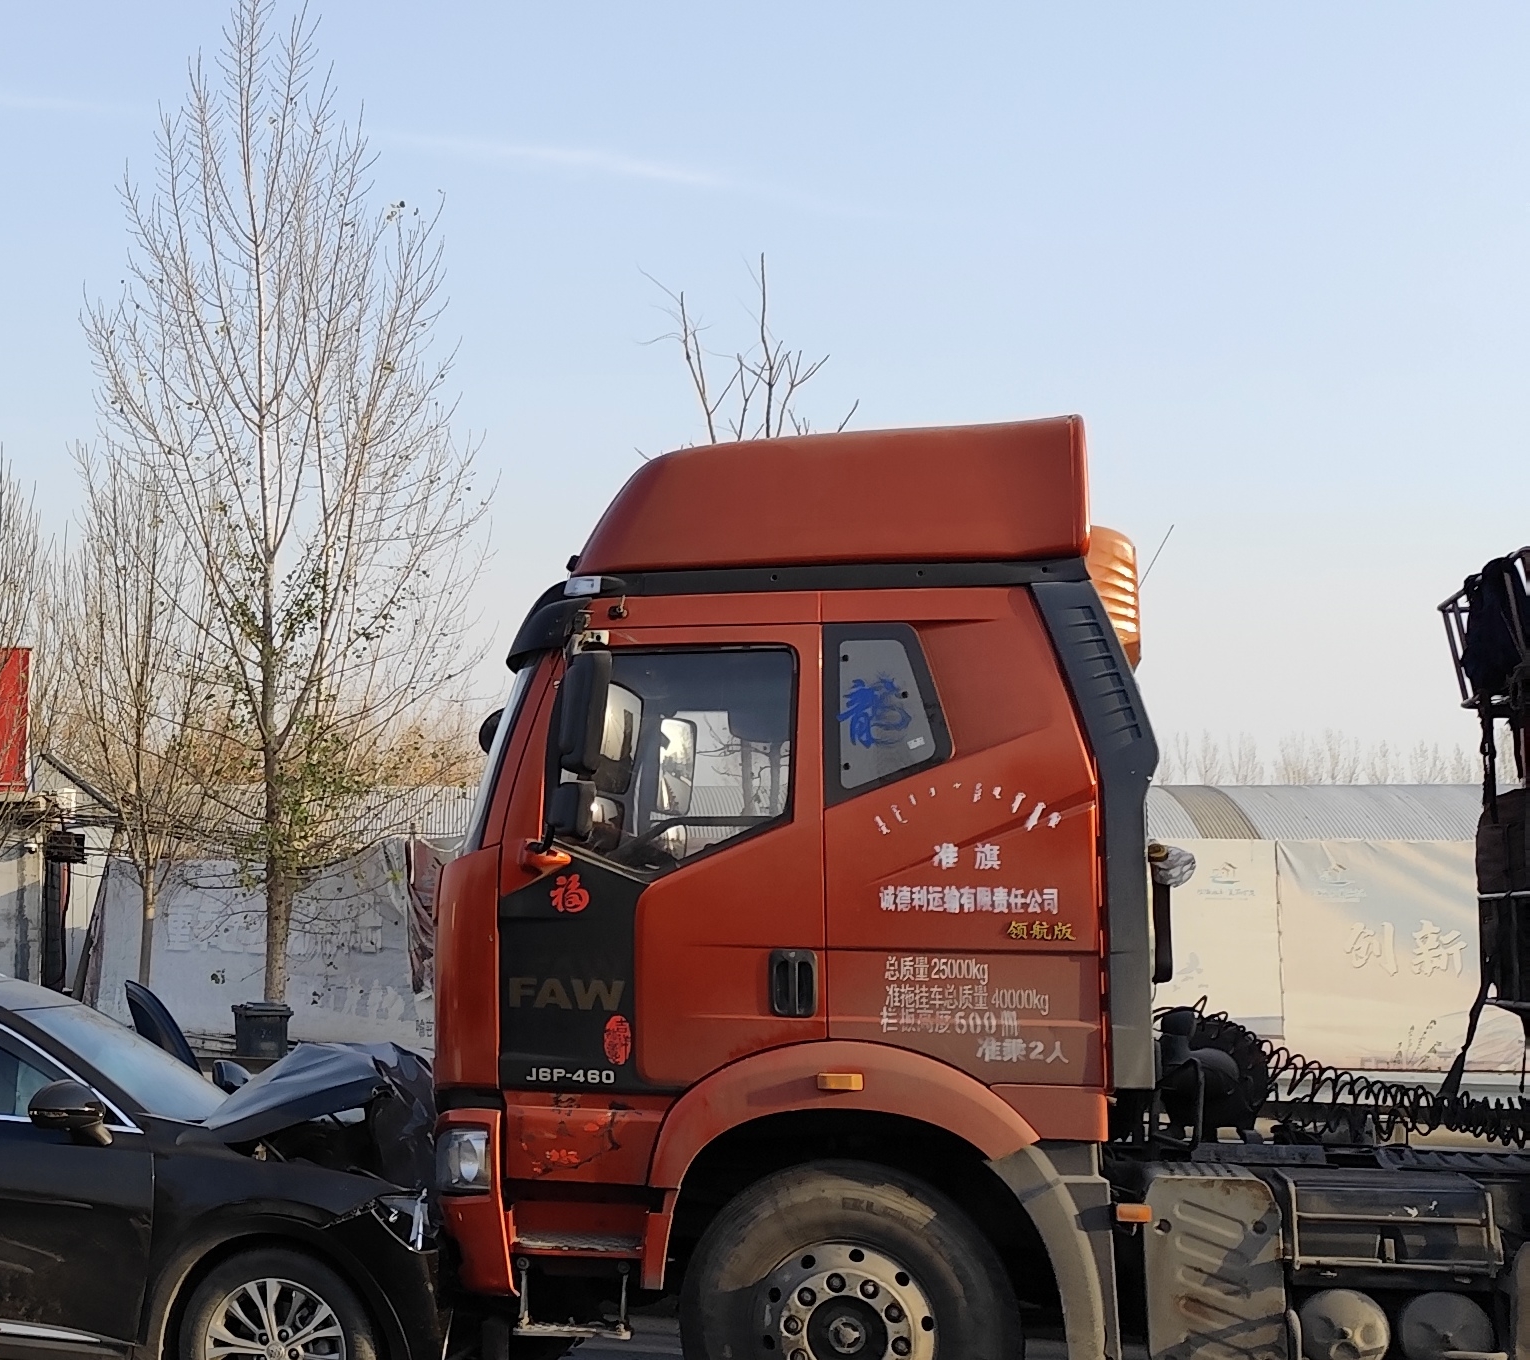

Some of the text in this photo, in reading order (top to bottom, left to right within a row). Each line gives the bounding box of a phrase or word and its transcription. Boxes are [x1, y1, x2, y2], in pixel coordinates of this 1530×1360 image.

[550, 874, 590, 913] 福
[879, 886, 1059, 914] 诚德利运输有限责任公司
[1007, 920, 1076, 940] 领航版
[1345, 920, 1468, 978] 创新
[509, 977, 625, 1011] FAW
[976, 1038, 1069, 1064] 准乘2人
[526, 1068, 615, 1084] J6P-460
